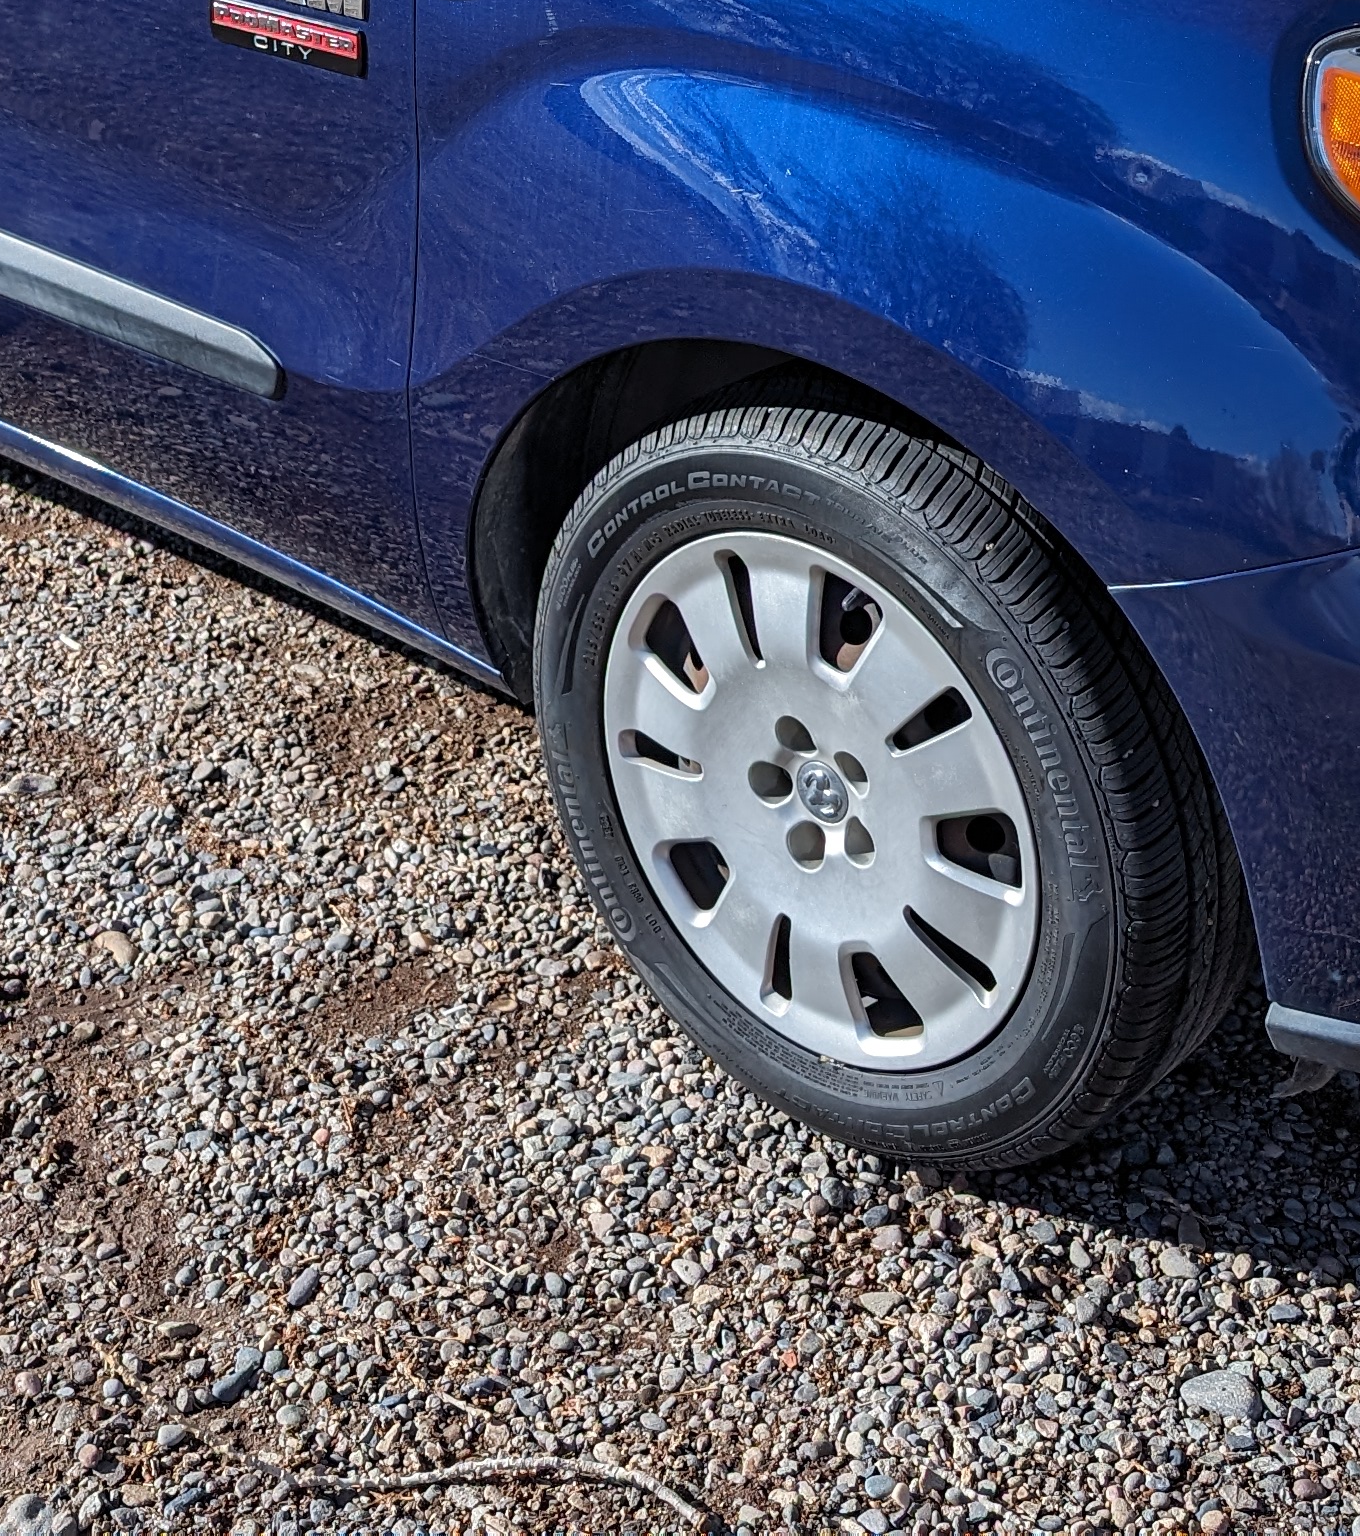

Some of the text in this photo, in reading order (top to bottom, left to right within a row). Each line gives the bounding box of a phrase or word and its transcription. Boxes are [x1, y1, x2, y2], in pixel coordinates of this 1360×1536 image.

[213, 2, 356, 52] PROMASTER
[254, 35, 312, 60] CITY
[661, 510, 701, 540] RADIAL
[986, 648, 1099, 868] Continental
[551, 750, 636, 941] Continental
